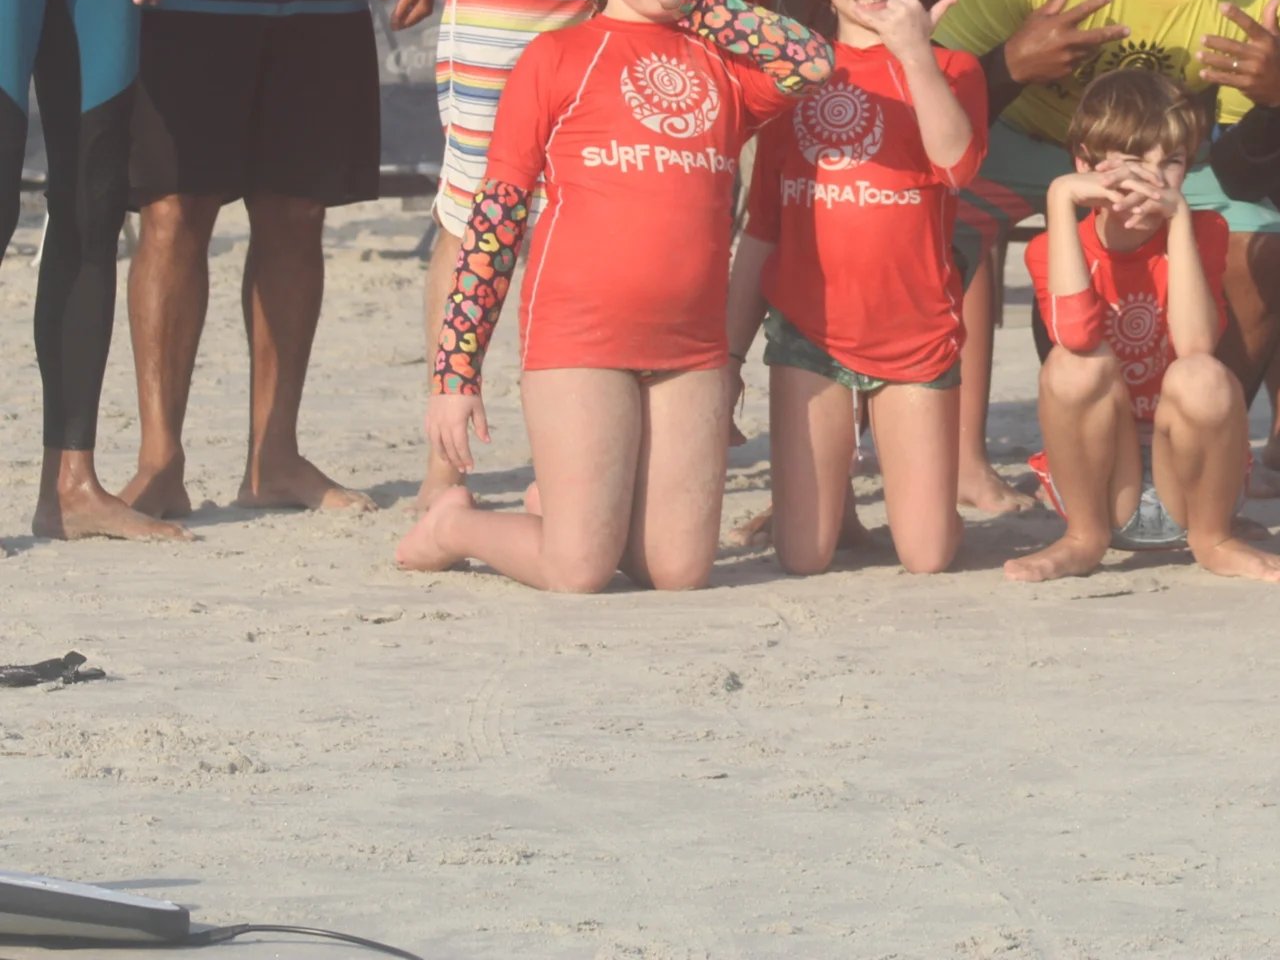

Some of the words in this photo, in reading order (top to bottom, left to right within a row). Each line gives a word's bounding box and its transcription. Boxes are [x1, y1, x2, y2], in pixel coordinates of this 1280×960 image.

[581, 139, 651, 173] SURF
[654, 145, 709, 174] PARA
[806, 179, 856, 210] PARA
[855, 179, 921, 208] TODOS
